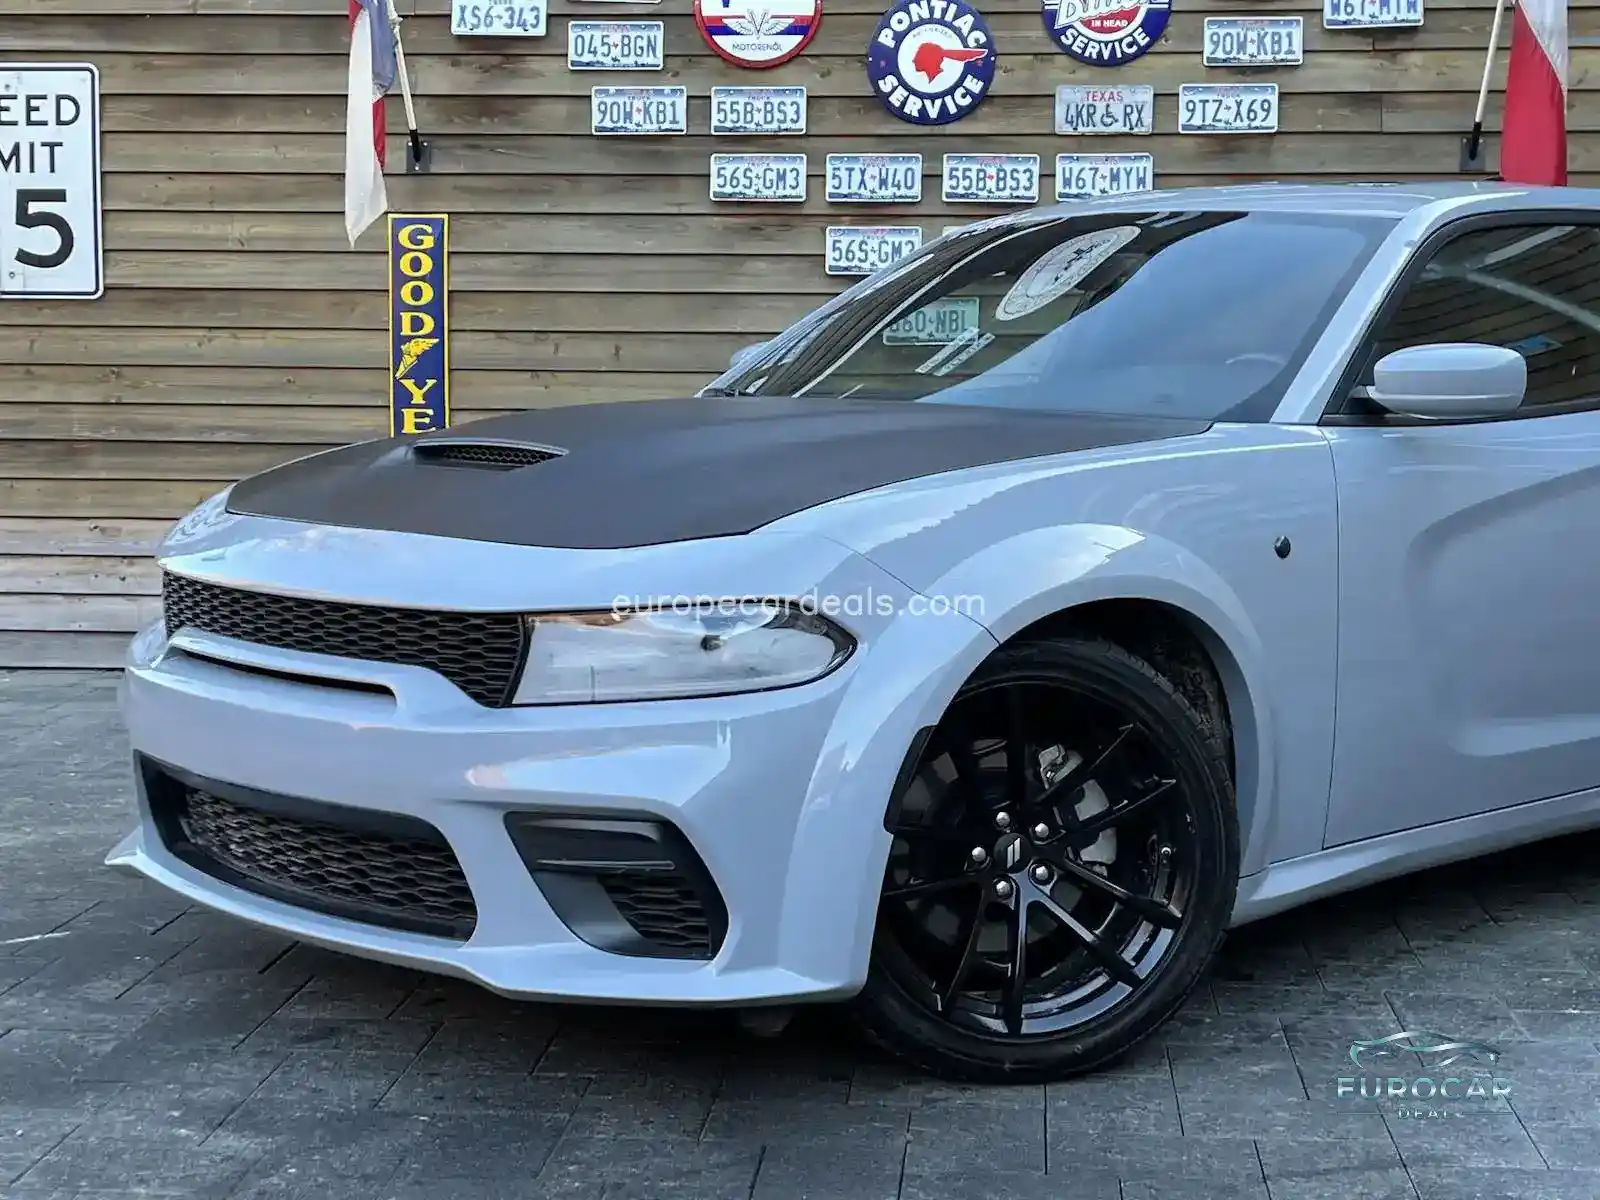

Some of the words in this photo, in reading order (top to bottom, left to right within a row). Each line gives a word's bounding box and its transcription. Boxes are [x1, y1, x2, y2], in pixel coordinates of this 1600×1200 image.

[878, 0, 987, 48] PONTIAC
[1060, 27, 1150, 60] SERVICE
[878, 74, 985, 119] SERVICE
[1065, 103, 1096, 128] 4KR
[1123, 103, 1145, 128] RX
[1084, 90, 1124, 103] TEXAS
[14, 189, 74, 268] 5
